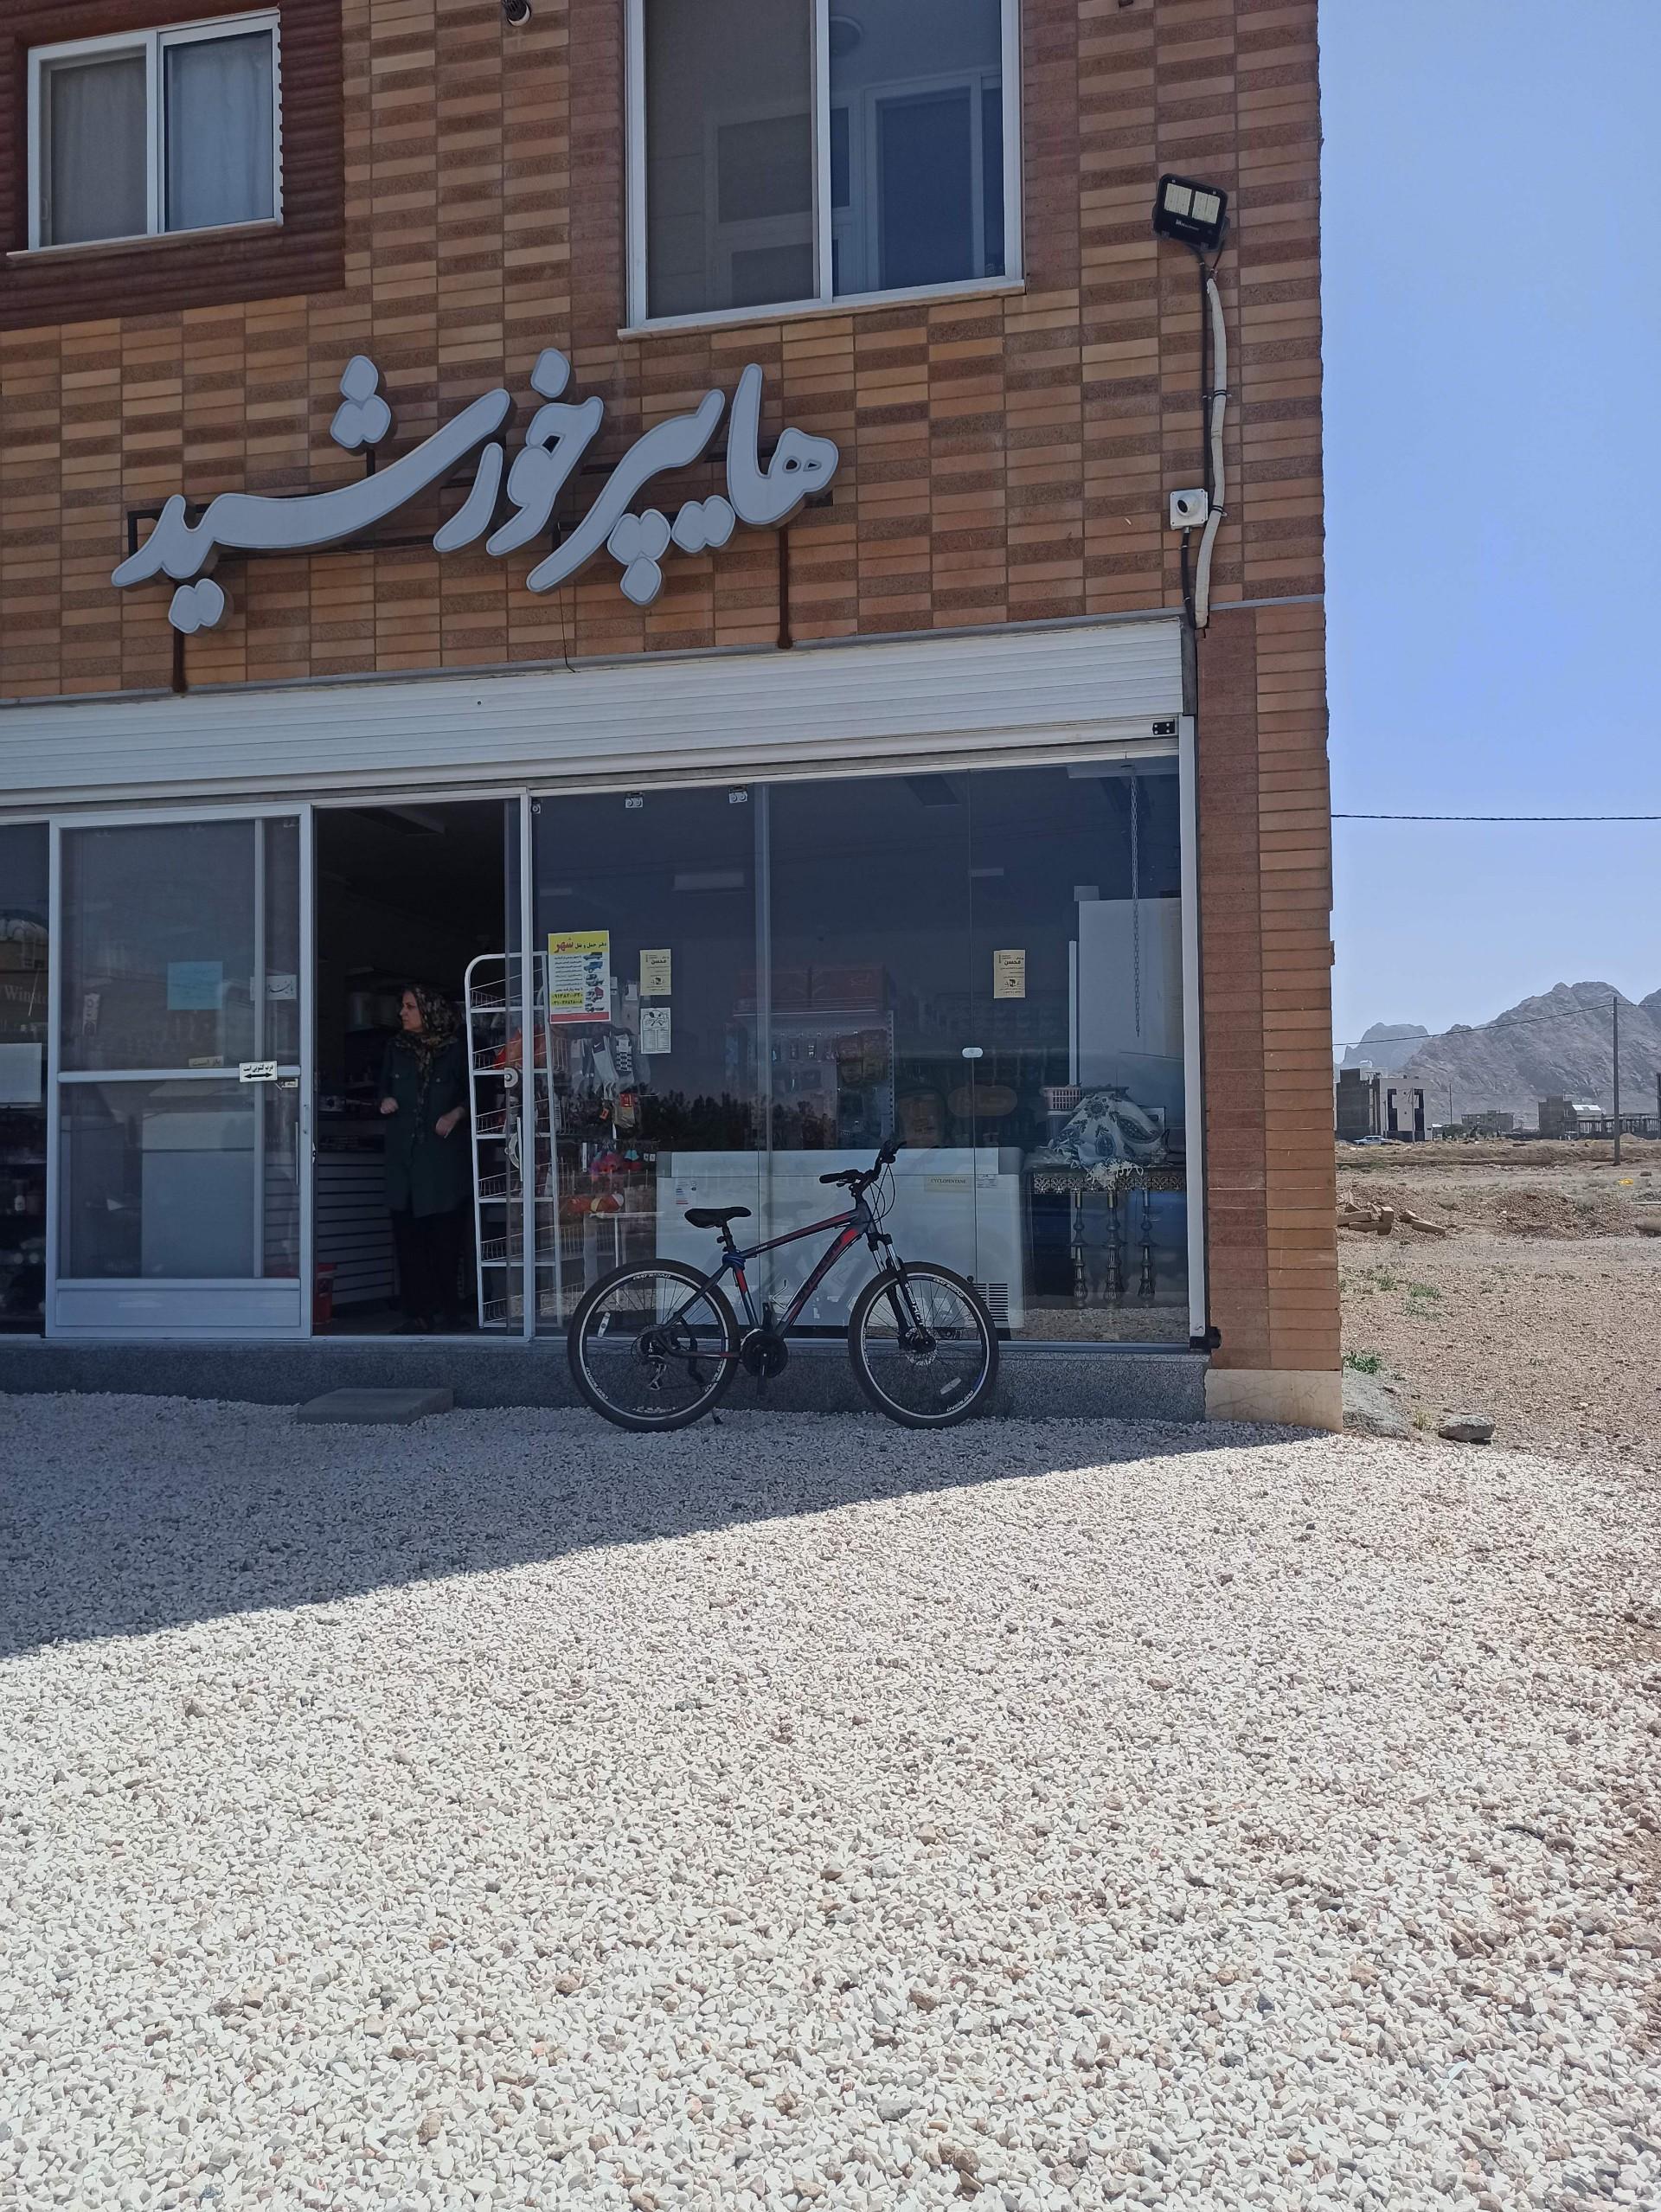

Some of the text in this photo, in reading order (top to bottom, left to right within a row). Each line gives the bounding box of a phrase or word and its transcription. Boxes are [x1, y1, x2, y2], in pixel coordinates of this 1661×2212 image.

[111, 347, 841, 635] هایپر خورشید
[265, 1063, 274, 1072] درب
